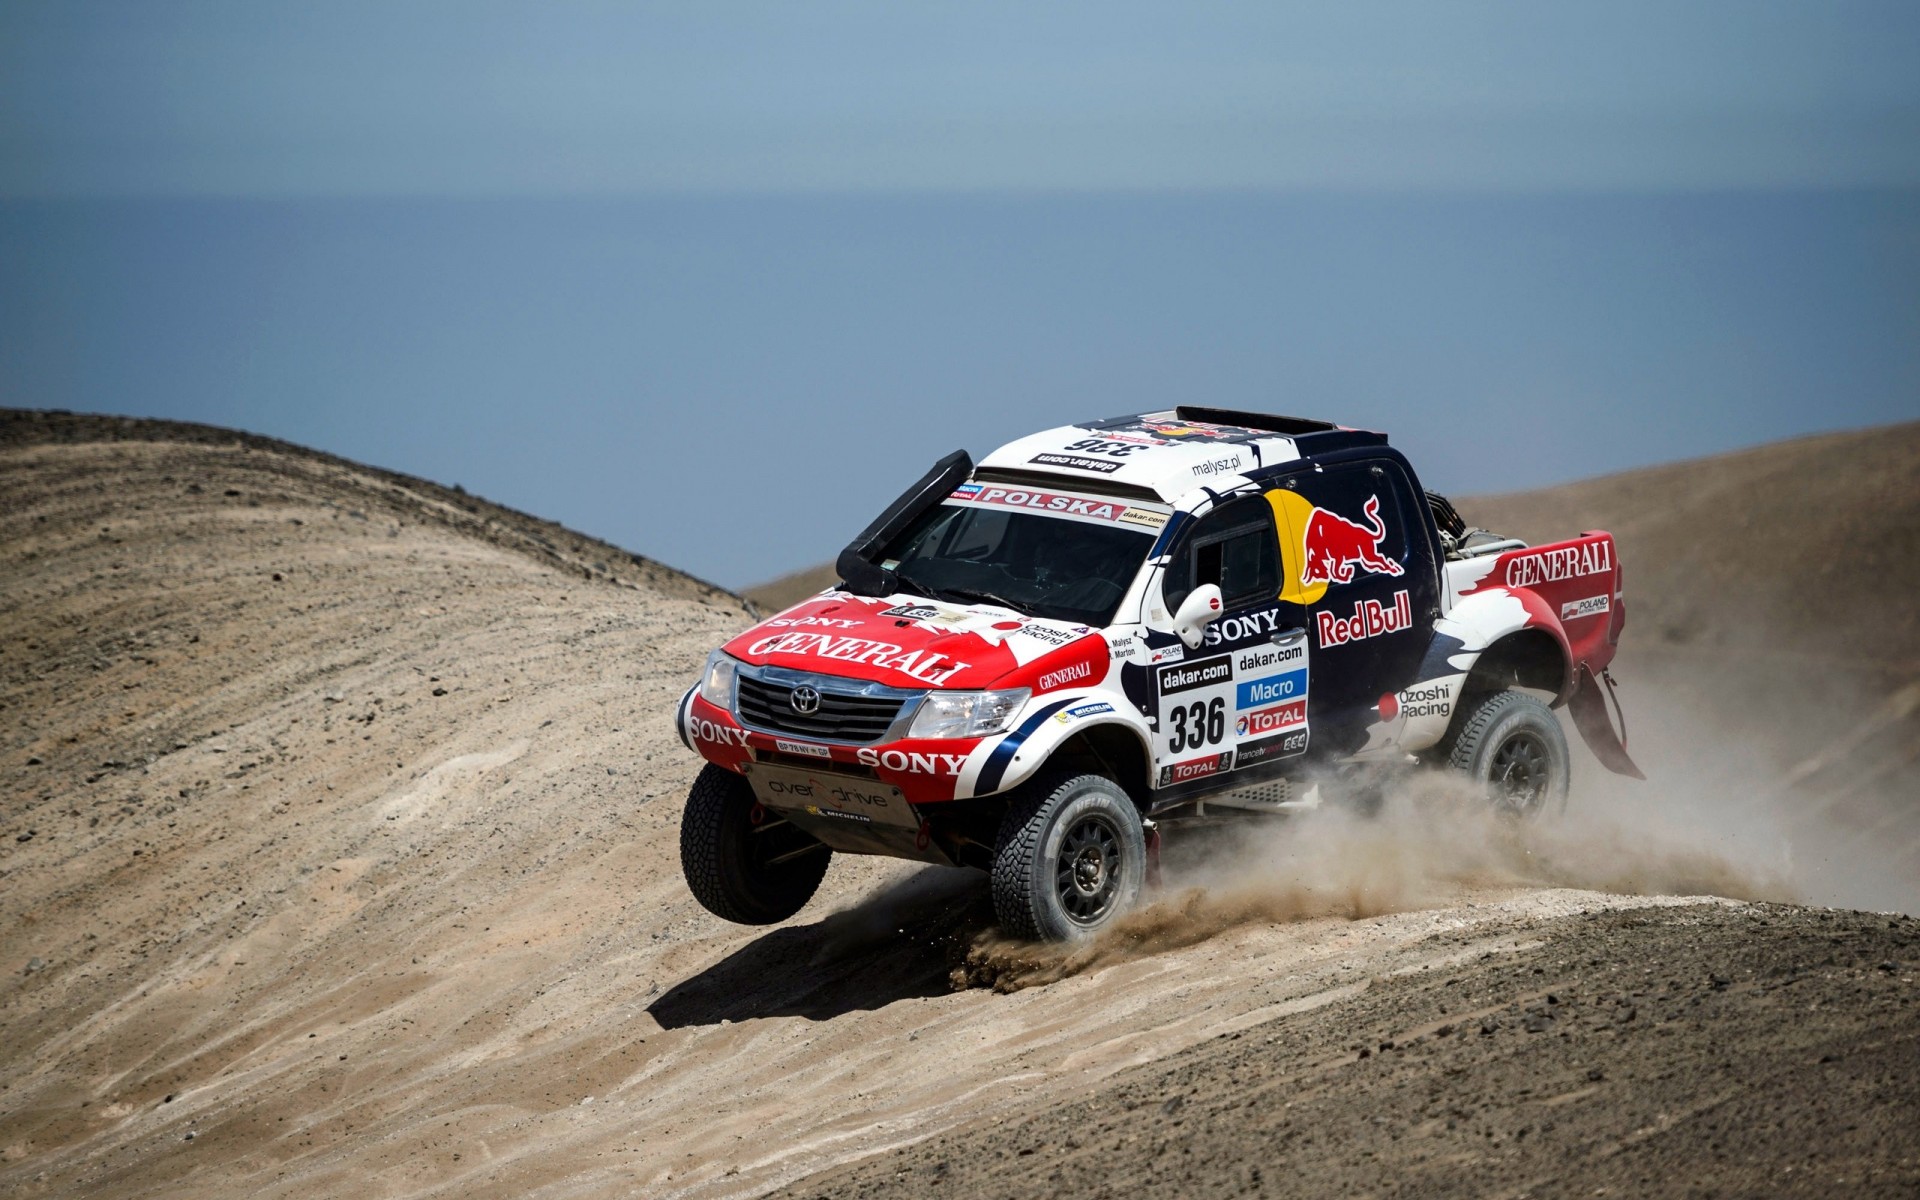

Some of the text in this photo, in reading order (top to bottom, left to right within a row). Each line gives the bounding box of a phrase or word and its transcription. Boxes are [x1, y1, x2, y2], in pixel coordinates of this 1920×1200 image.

[1064, 439, 1149, 457] 336
[1038, 454, 1116, 473] dakar.com
[1192, 454, 1242, 477] malysz.pl
[982, 490, 1114, 519] POLSKA
[1123, 511, 1166, 525] dakar.com
[1506, 540, 1612, 588] GENERALI
[1580, 597, 1608, 609] POLAND
[766, 617, 865, 629] SONY
[1203, 608, 1279, 647] SONY
[1317, 589, 1412, 649] Red Bull
[1015, 628, 1064, 645] Racing
[1025, 624, 1076, 640] Ozoshi
[1112, 637, 1132, 648] Malysz
[748, 632, 972, 687] GENERALI
[1114, 648, 1136, 659] Marton
[1240, 646, 1302, 671] dakar.com
[1039, 661, 1091, 690] GENERALI
[1163, 663, 1229, 689] dakar.com
[1250, 680, 1294, 703] Macro
[1400, 684, 1449, 704] Ozoshi
[1074, 703, 1111, 716] MICHELIN
[1252, 708, 1303, 730] TOTAL
[1400, 701, 1450, 719] Racing
[690, 715, 752, 748] SONY
[1169, 696, 1225, 754] 336
[856, 748, 969, 776] SONY
[1176, 761, 1217, 778] TOTAL
[768, 781, 814, 797] over
[827, 810, 870, 822] MICHELIN
